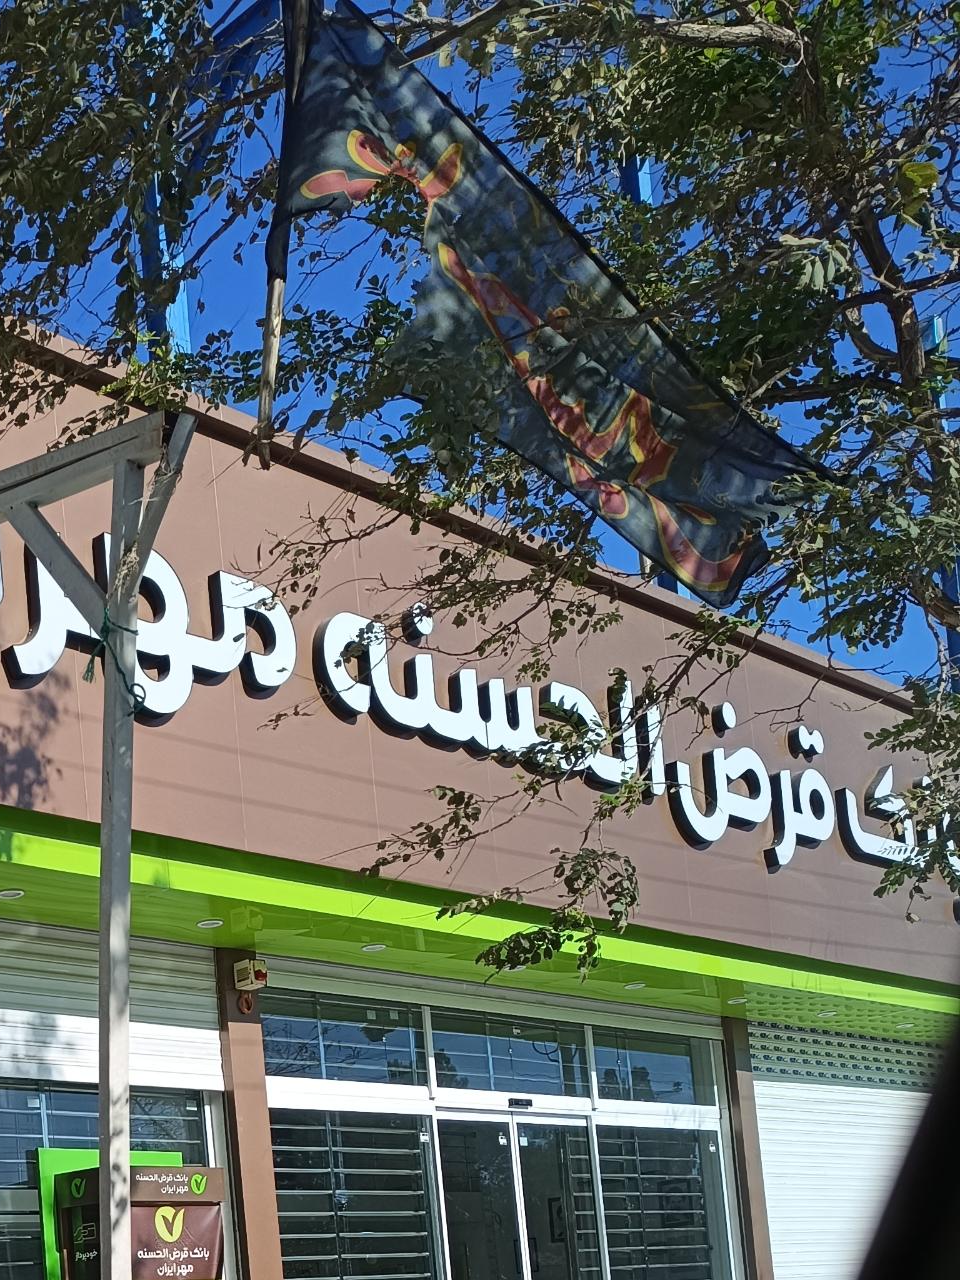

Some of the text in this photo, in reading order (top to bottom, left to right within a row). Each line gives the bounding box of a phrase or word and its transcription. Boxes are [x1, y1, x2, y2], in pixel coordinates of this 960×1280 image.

[2, 533, 297, 727] مهر
[314, 602, 666, 804] الحسنه
[667, 701, 836, 874] قرض
[135, 1172, 189, 1184] بانک قرض الحسنه
[160, 1184, 189, 1194] مهر ایران
[74, 1249, 98, 1262] خودپرداز
[137, 1247, 210, 1262] بانک قرض الحسنه
[156, 1262, 194, 1277] مهر ایران
